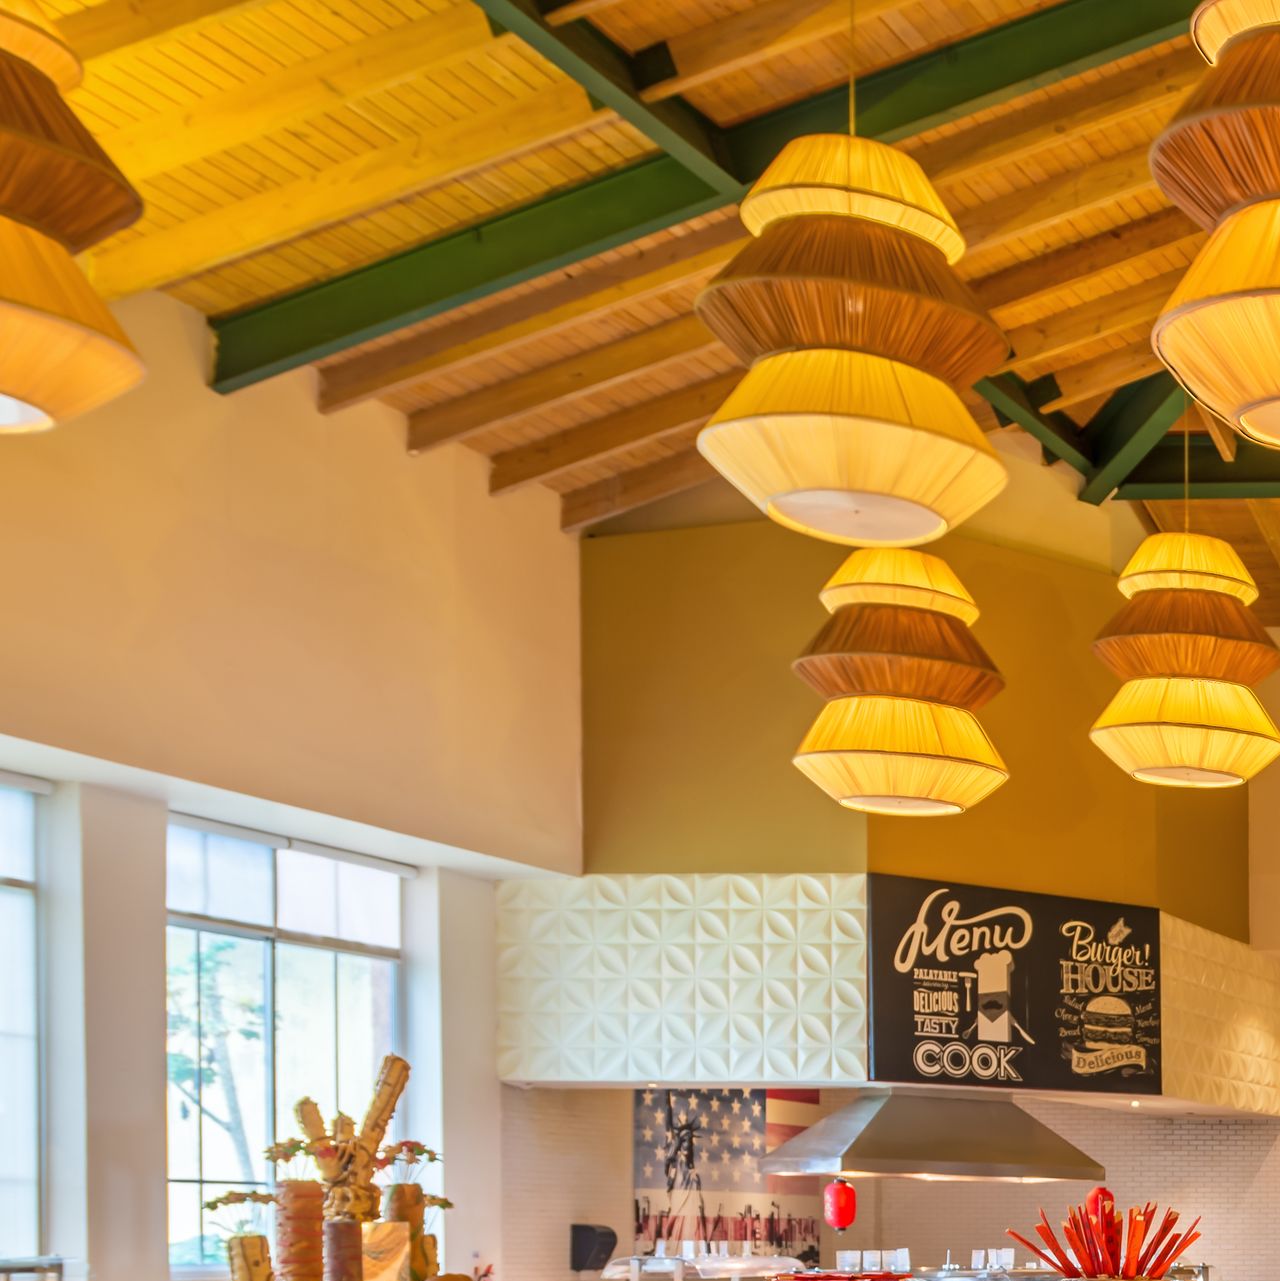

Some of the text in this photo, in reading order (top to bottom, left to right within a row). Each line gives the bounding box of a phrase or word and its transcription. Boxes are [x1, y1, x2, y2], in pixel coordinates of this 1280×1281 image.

[893, 888, 1033, 974] Menu
[1059, 920, 1151, 977] Burger!
[913, 967, 959, 983] PALATABLE
[1059, 960, 1156, 994] HOUSE
[913, 990, 959, 1014] DELICIOUS
[914, 1016, 959, 1035] TASTY
[912, 1040, 1023, 1082] COOK
[1075, 1049, 1142, 1070] Delicious
